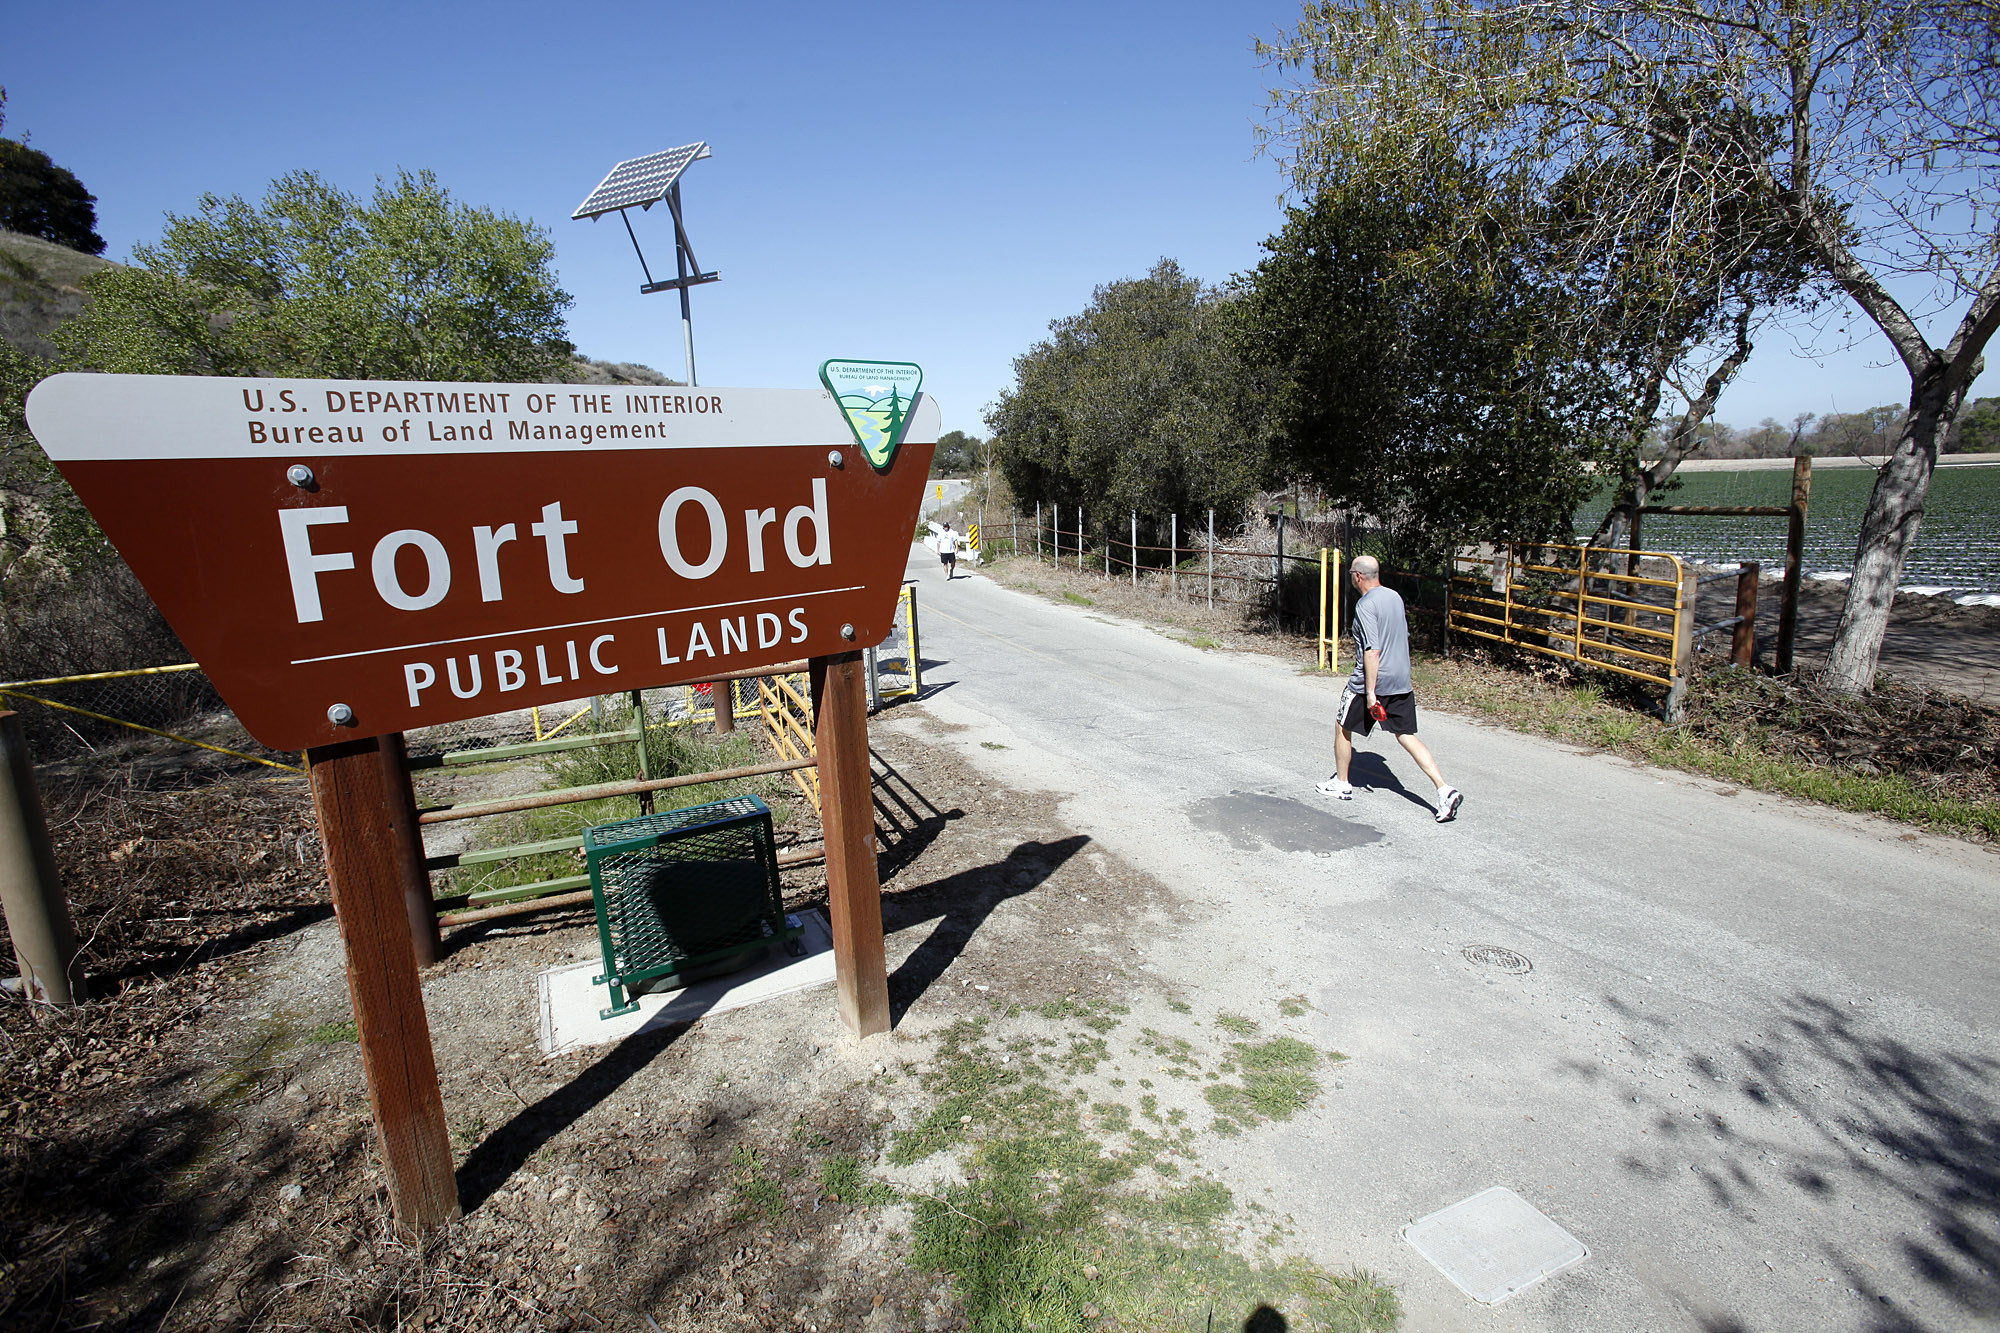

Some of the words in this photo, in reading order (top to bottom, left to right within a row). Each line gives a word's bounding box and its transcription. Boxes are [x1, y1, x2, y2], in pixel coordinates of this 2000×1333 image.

[243, 389, 307, 413] U.S.
[326, 391, 510, 413] DEPARTMENT
[527, 394, 557, 413] OF
[569, 395, 613, 413] THE
[626, 395, 723, 414] INTERIOR
[248, 421, 364, 444] Bureau
[382, 420, 411, 442] of
[428, 420, 493, 442] Land
[509, 421, 667, 445] Management
[278, 501, 585, 623] Fort
[658, 478, 832, 579] Ord
[403, 635, 619, 708] PUBLIC
[657, 608, 808, 666] LANDS
